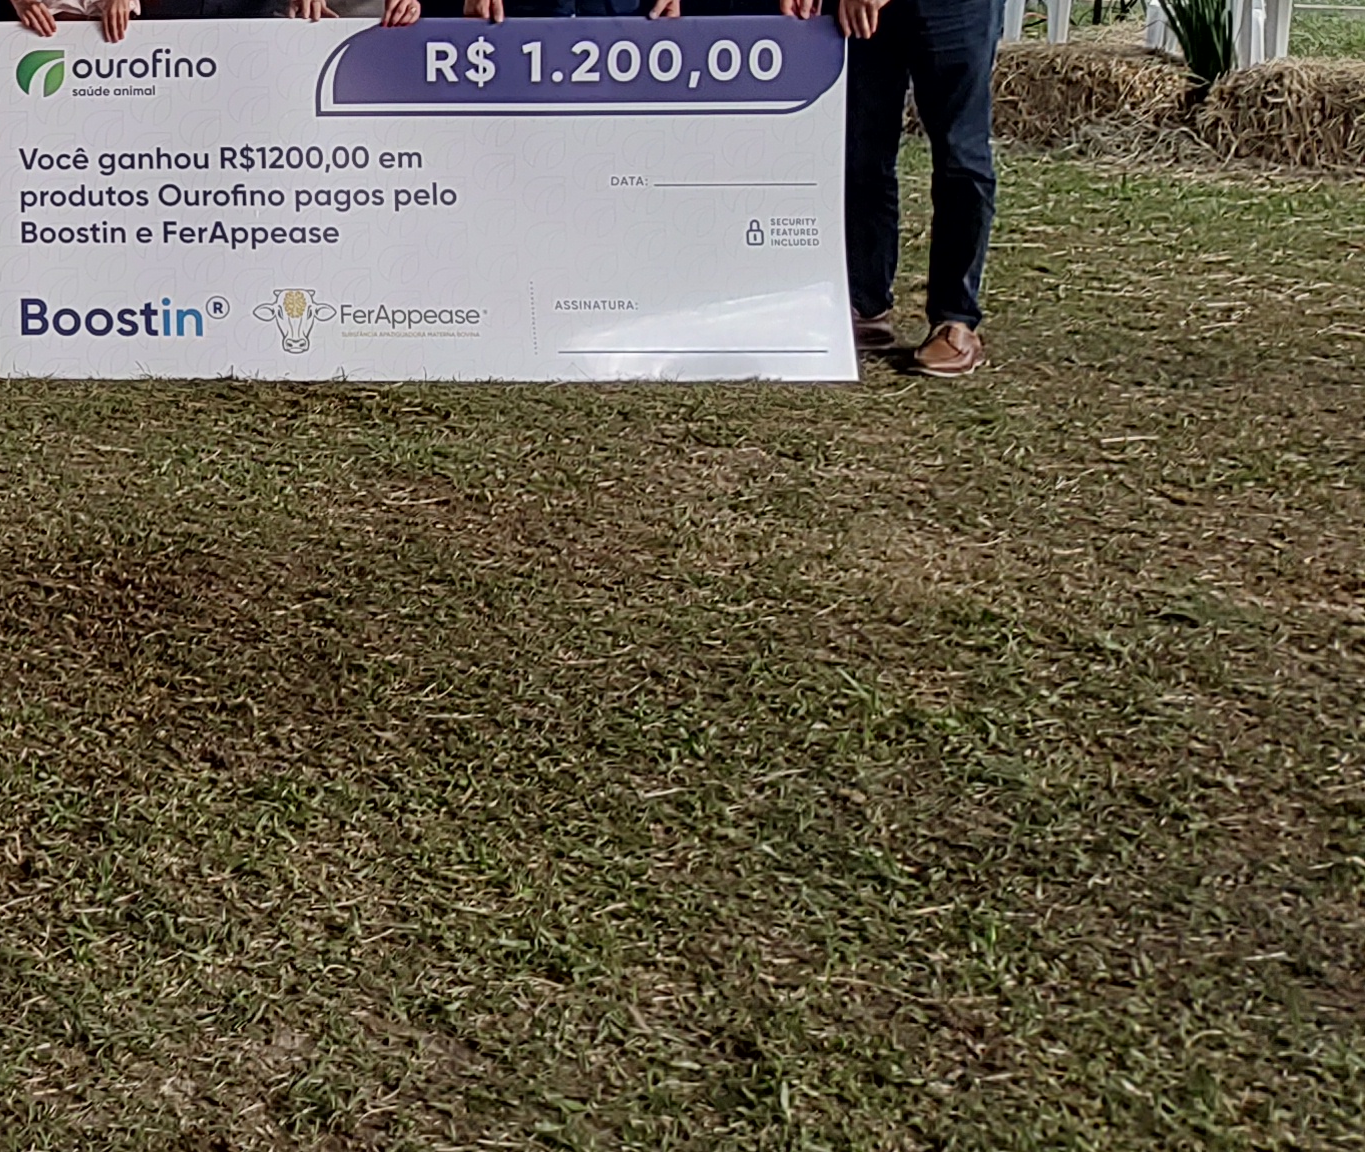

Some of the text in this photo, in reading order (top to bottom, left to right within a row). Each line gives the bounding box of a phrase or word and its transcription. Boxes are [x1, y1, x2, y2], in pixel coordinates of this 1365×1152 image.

[72, 48, 217, 79] ourofino
[425, 36, 784, 89] R$ 1.200,00
[72, 85, 156, 97] saúde animal
[19, 144, 423, 176] Você ganhou R$1200,00 em
[610, 176, 649, 187] DATA:
[20, 182, 458, 213] produtos Ourofino pagos pelo
[770, 218, 817, 226] SECURITY
[20, 221, 340, 250] Boostin e FerAppease
[770, 228, 819, 236] FEATURED
[770, 238, 820, 247] INCLUDED
[554, 300, 639, 310] ASSINATURA:
[340, 304, 481, 330] FerAppease
